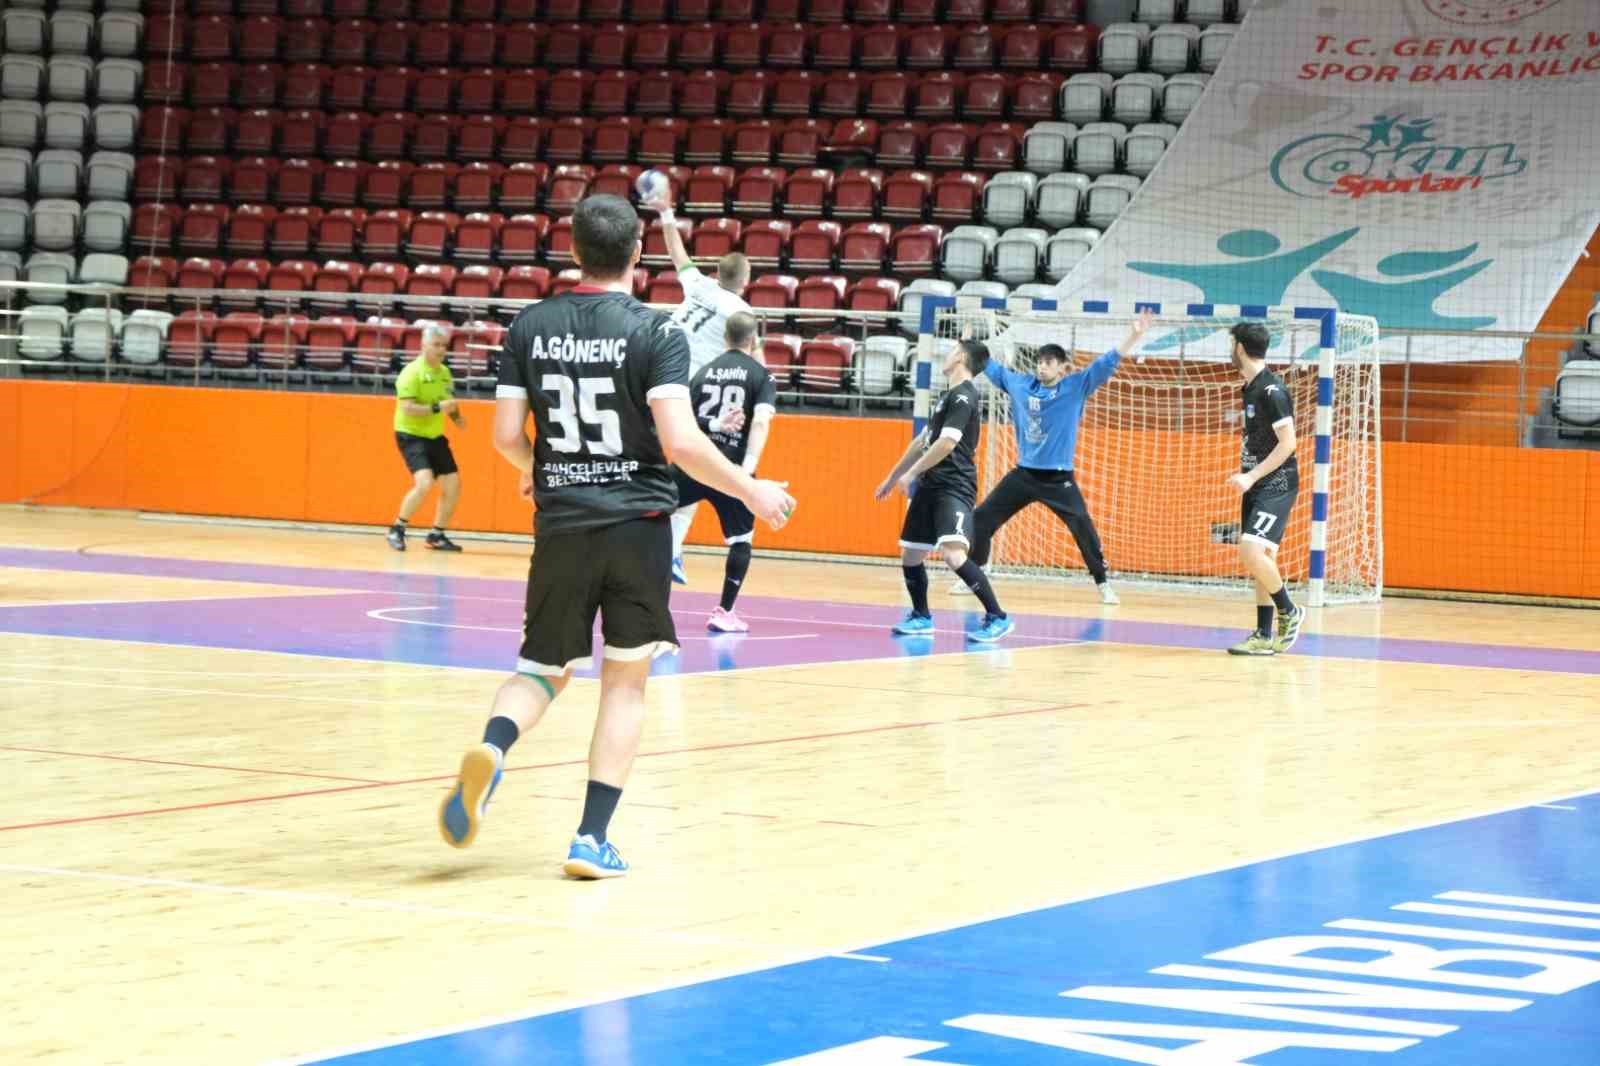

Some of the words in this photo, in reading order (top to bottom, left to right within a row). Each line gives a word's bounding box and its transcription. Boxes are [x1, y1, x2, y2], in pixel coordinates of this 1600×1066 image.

[1315, 35, 1376, 57] T.C.
[1297, 61, 1399, 83] SPOR
[532, 333, 627, 369] A.GÖNENÇ
[542, 374, 623, 456] 35
[699, 384, 746, 419] 28
